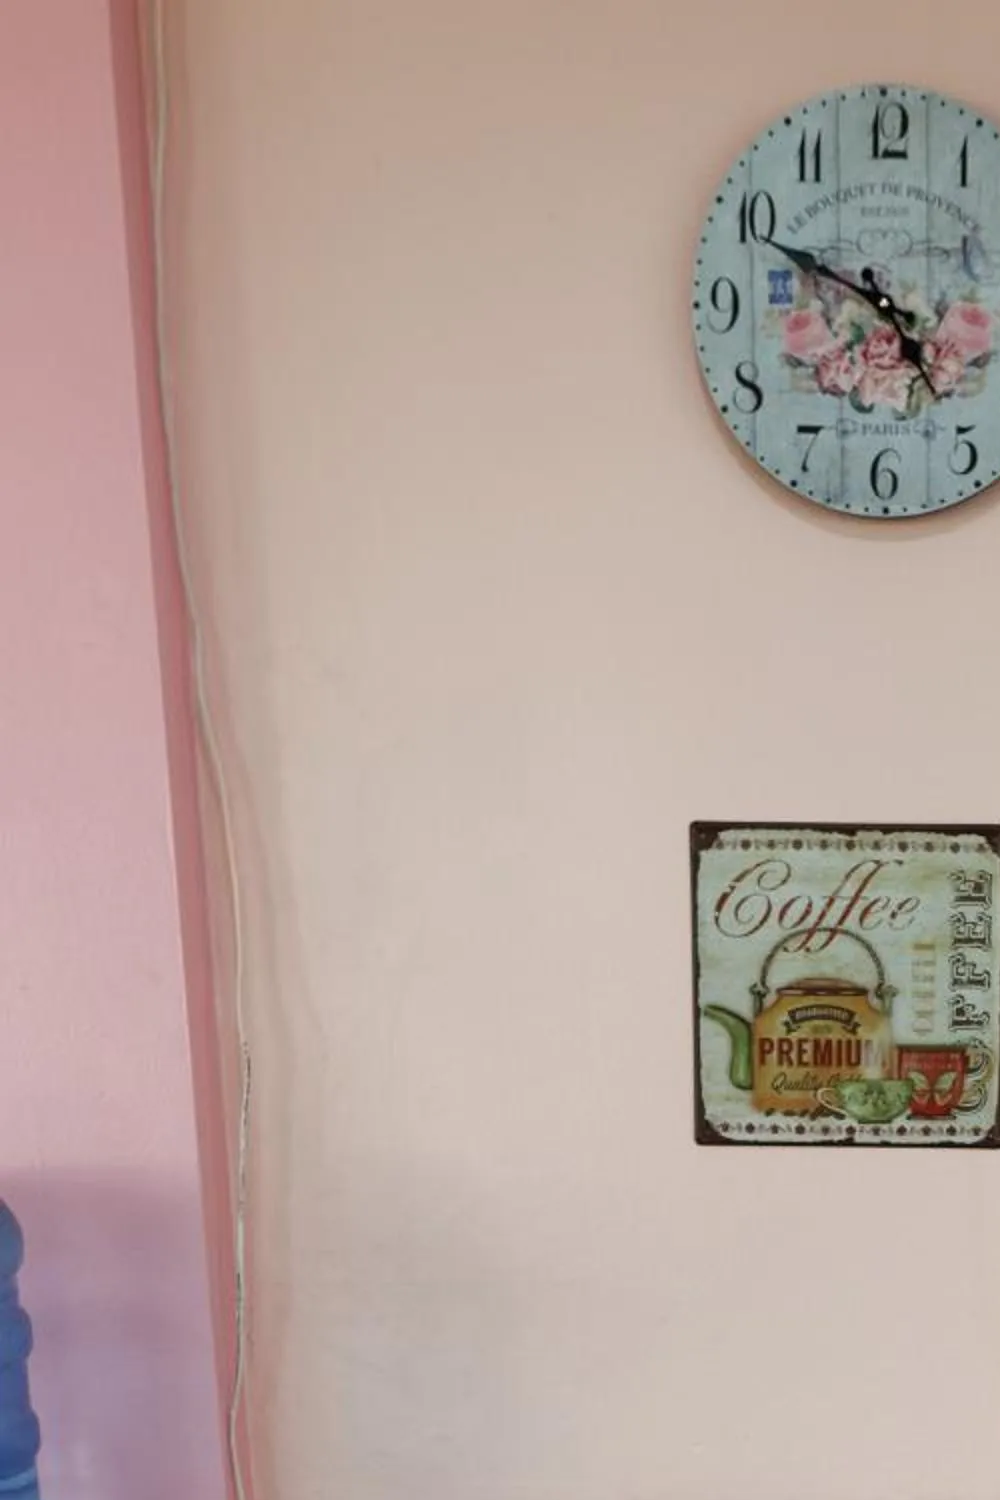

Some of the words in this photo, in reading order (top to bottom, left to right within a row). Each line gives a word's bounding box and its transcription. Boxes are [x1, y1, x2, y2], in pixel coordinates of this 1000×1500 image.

[797, 128, 822, 183] 11
[871, 102, 909, 159] 12
[958, 135, 968, 188] 1
[738, 189, 776, 243] 10
[786, 214, 807, 235] LE
[803, 184, 876, 218] BOUQUET
[881, 182, 899, 197] DE
[708, 276, 740, 334] 9
[732, 361, 763, 414] 8
[796, 425, 825, 472] 7
[862, 423, 911, 437] PARIS
[948, 425, 978, 475] 5
[870, 448, 898, 500] 6
[713, 858, 921, 953] Coffee
